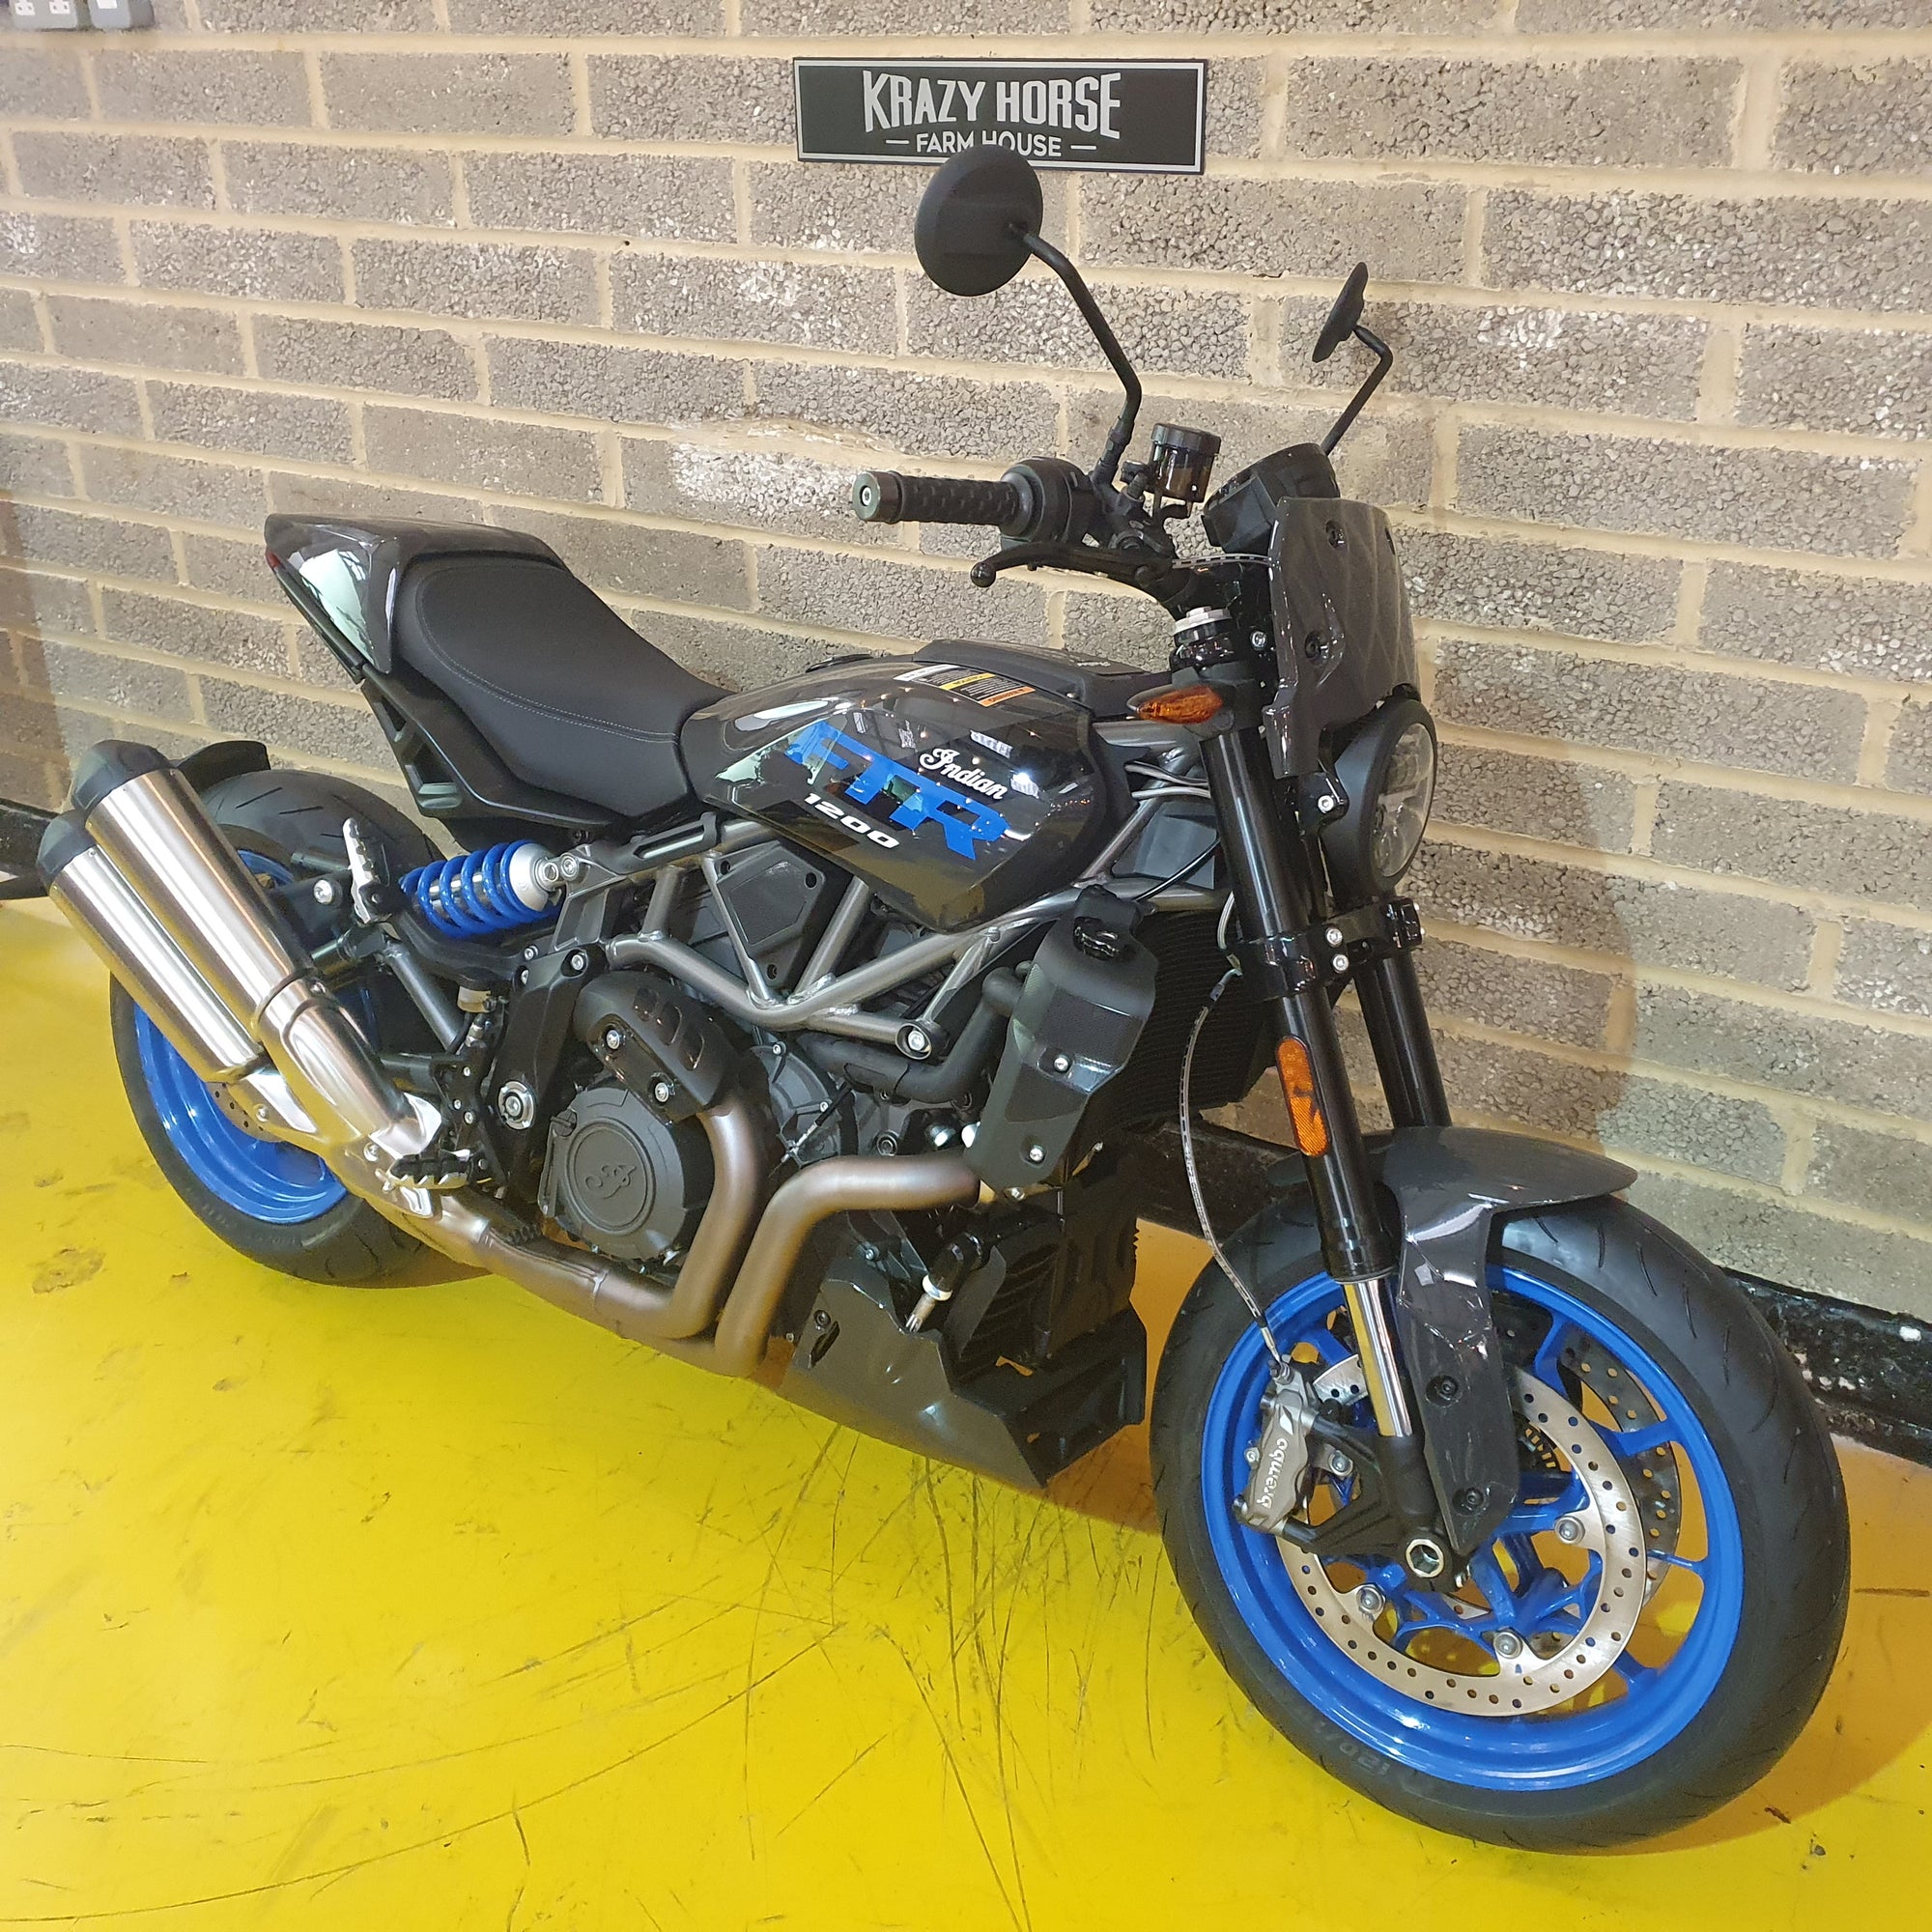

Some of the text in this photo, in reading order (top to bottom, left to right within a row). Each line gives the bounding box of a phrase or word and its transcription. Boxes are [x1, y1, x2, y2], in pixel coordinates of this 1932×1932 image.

[863, 70, 1122, 139] KRAZY HORSE
[916, 130, 1062, 156] FARM HOUSE
[783, 720, 1010, 861] FTR
[919, 747, 1008, 801] Indian
[804, 792, 900, 849] 1200
[1257, 1437, 1289, 1509] brembo
